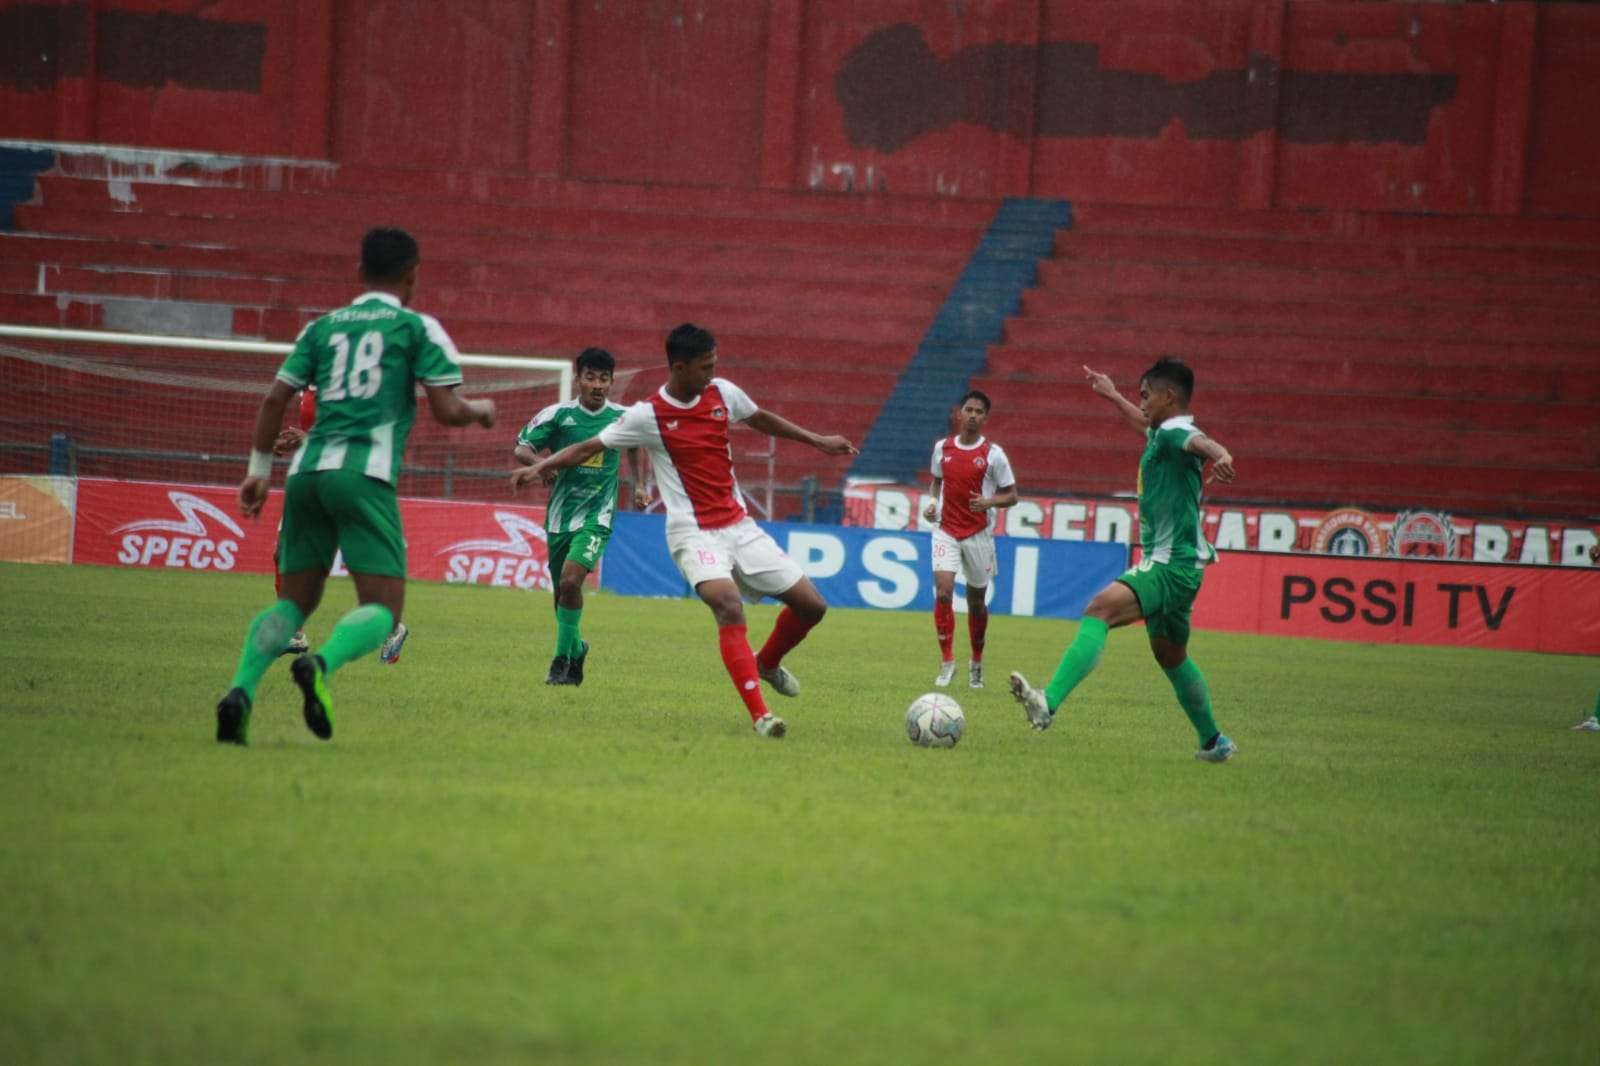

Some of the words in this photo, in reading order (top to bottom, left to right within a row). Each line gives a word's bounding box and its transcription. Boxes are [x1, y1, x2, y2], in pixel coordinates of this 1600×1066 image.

[320, 331, 384, 401] 18
[117, 534, 239, 571] SPECS
[1280, 575, 1416, 627] PSSI
[1437, 583, 1517, 631] TV
